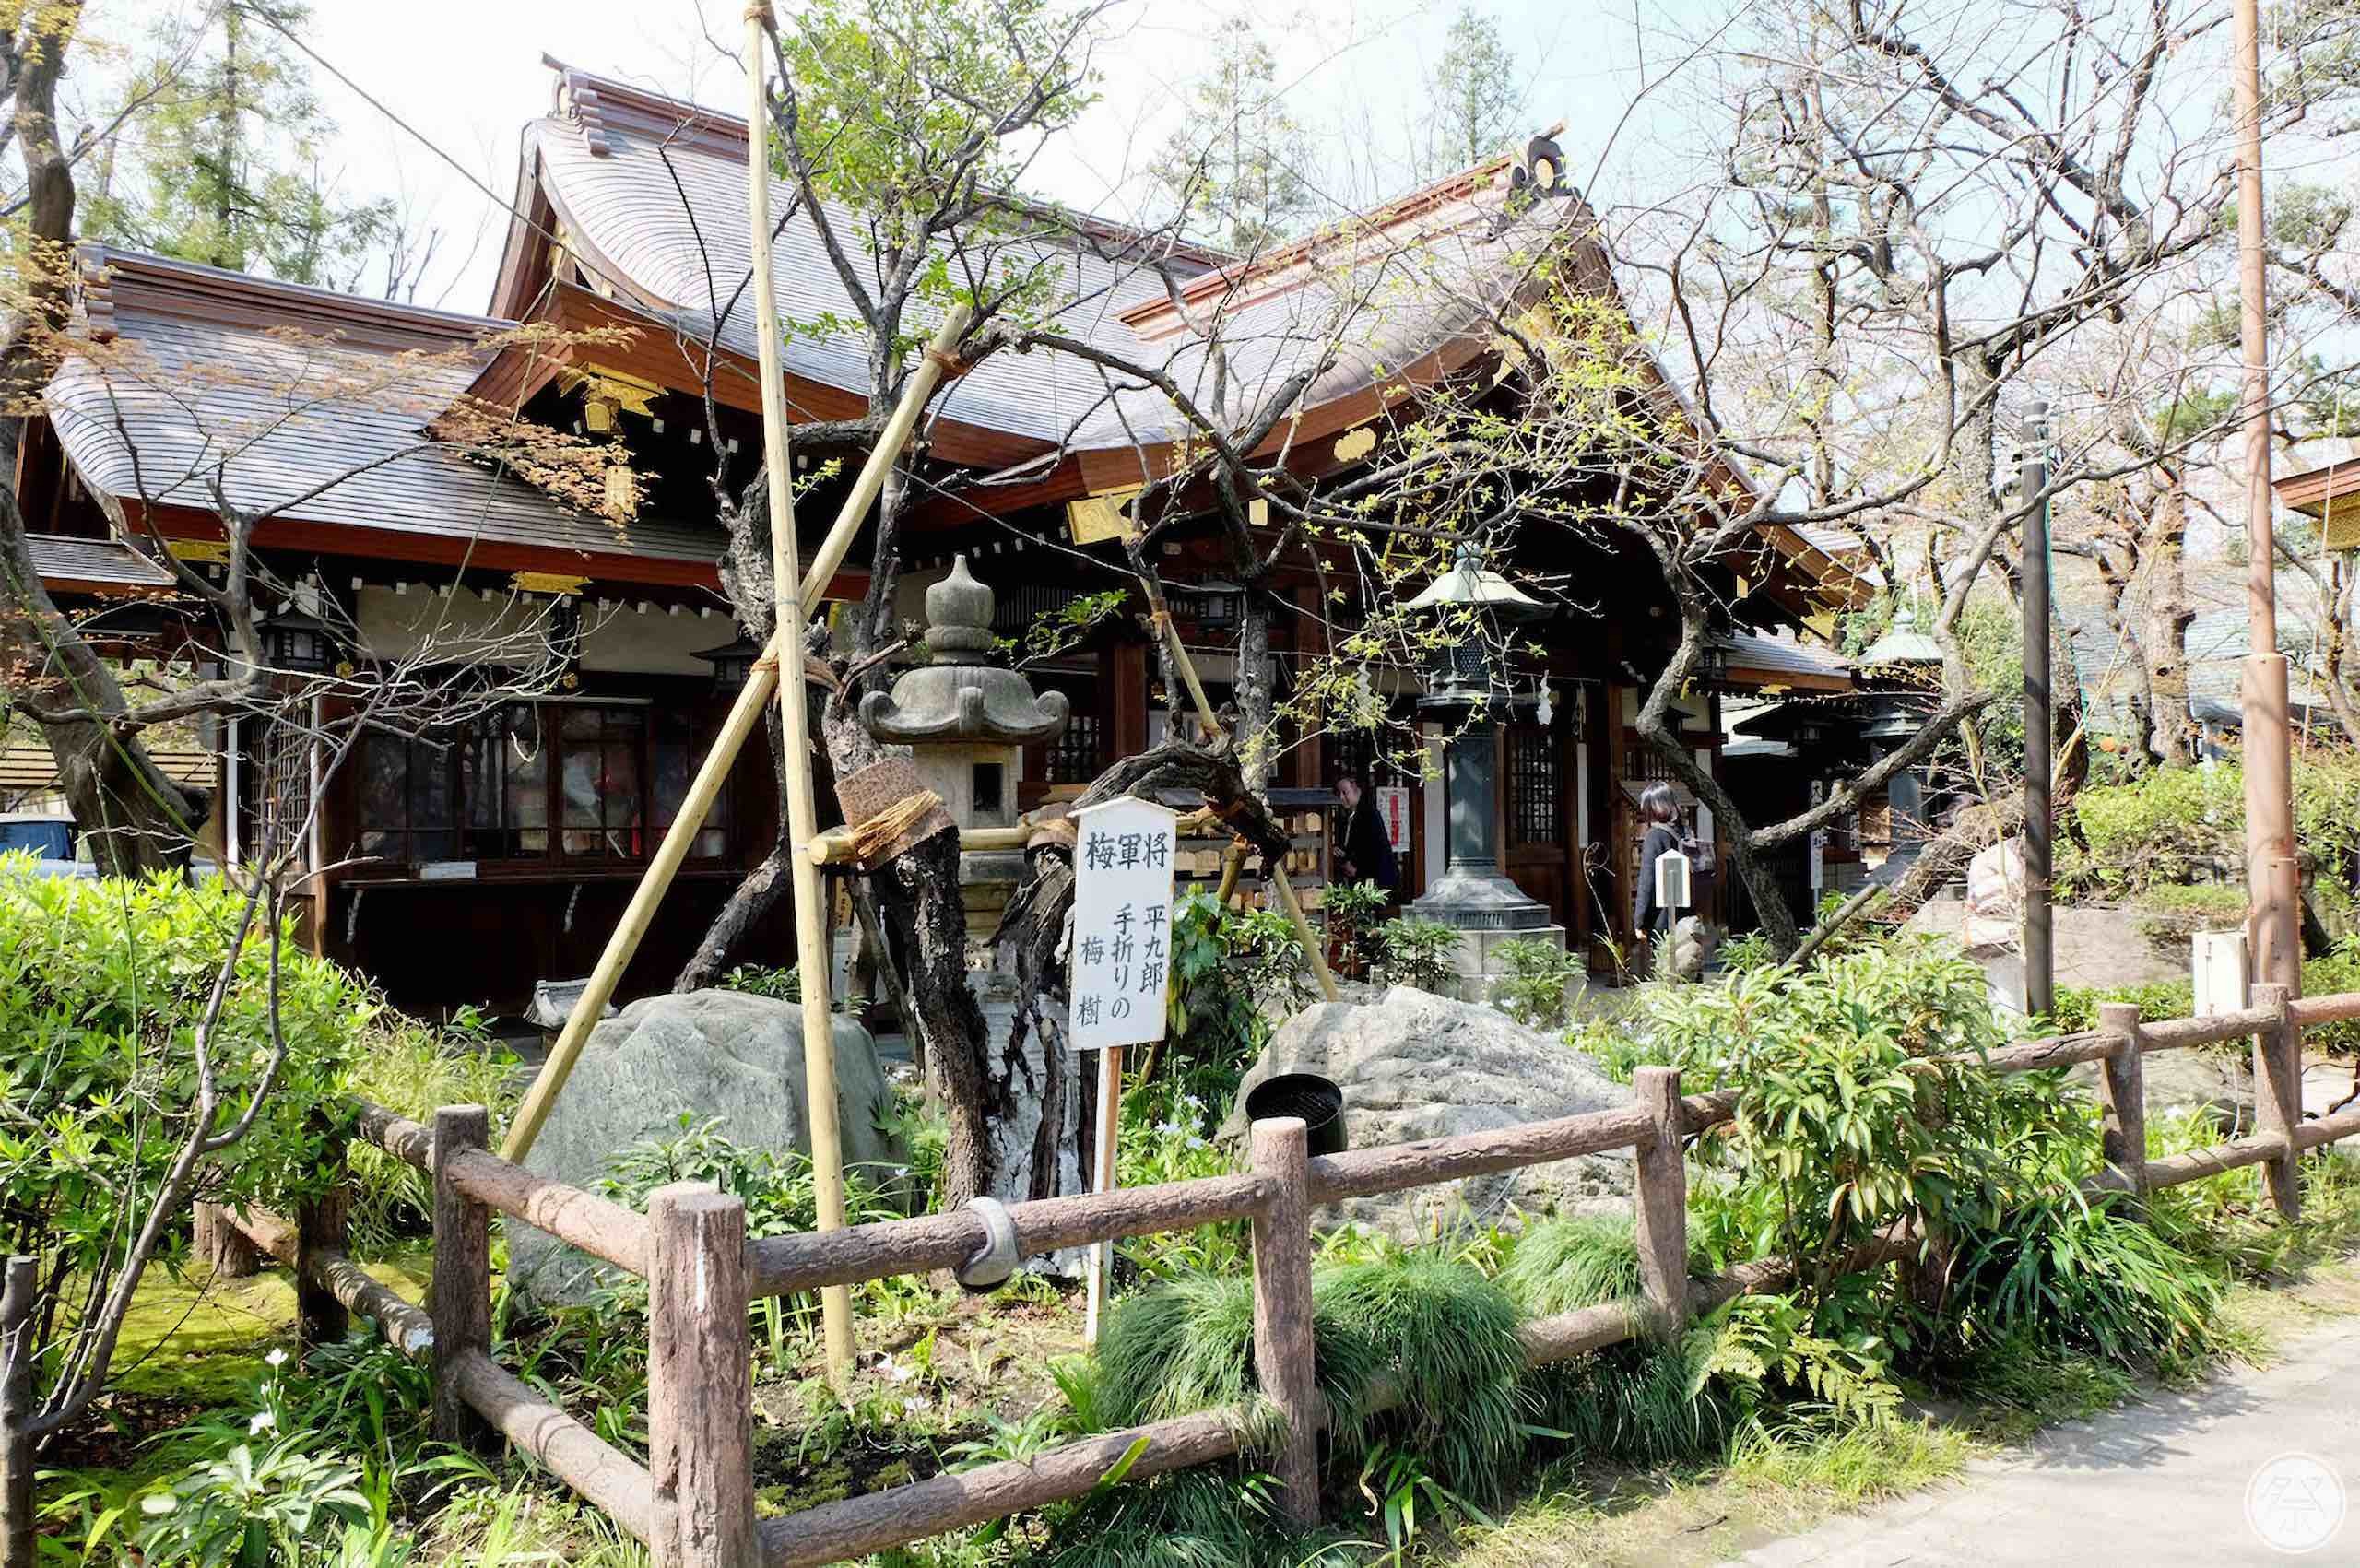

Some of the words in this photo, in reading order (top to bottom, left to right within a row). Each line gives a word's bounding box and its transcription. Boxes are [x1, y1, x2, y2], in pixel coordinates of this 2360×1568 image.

[1077, 935, 1104, 1027] 梅樹
[1110, 902, 1136, 1020] 手折りの
[1139, 904, 1166, 996] 平九郎
